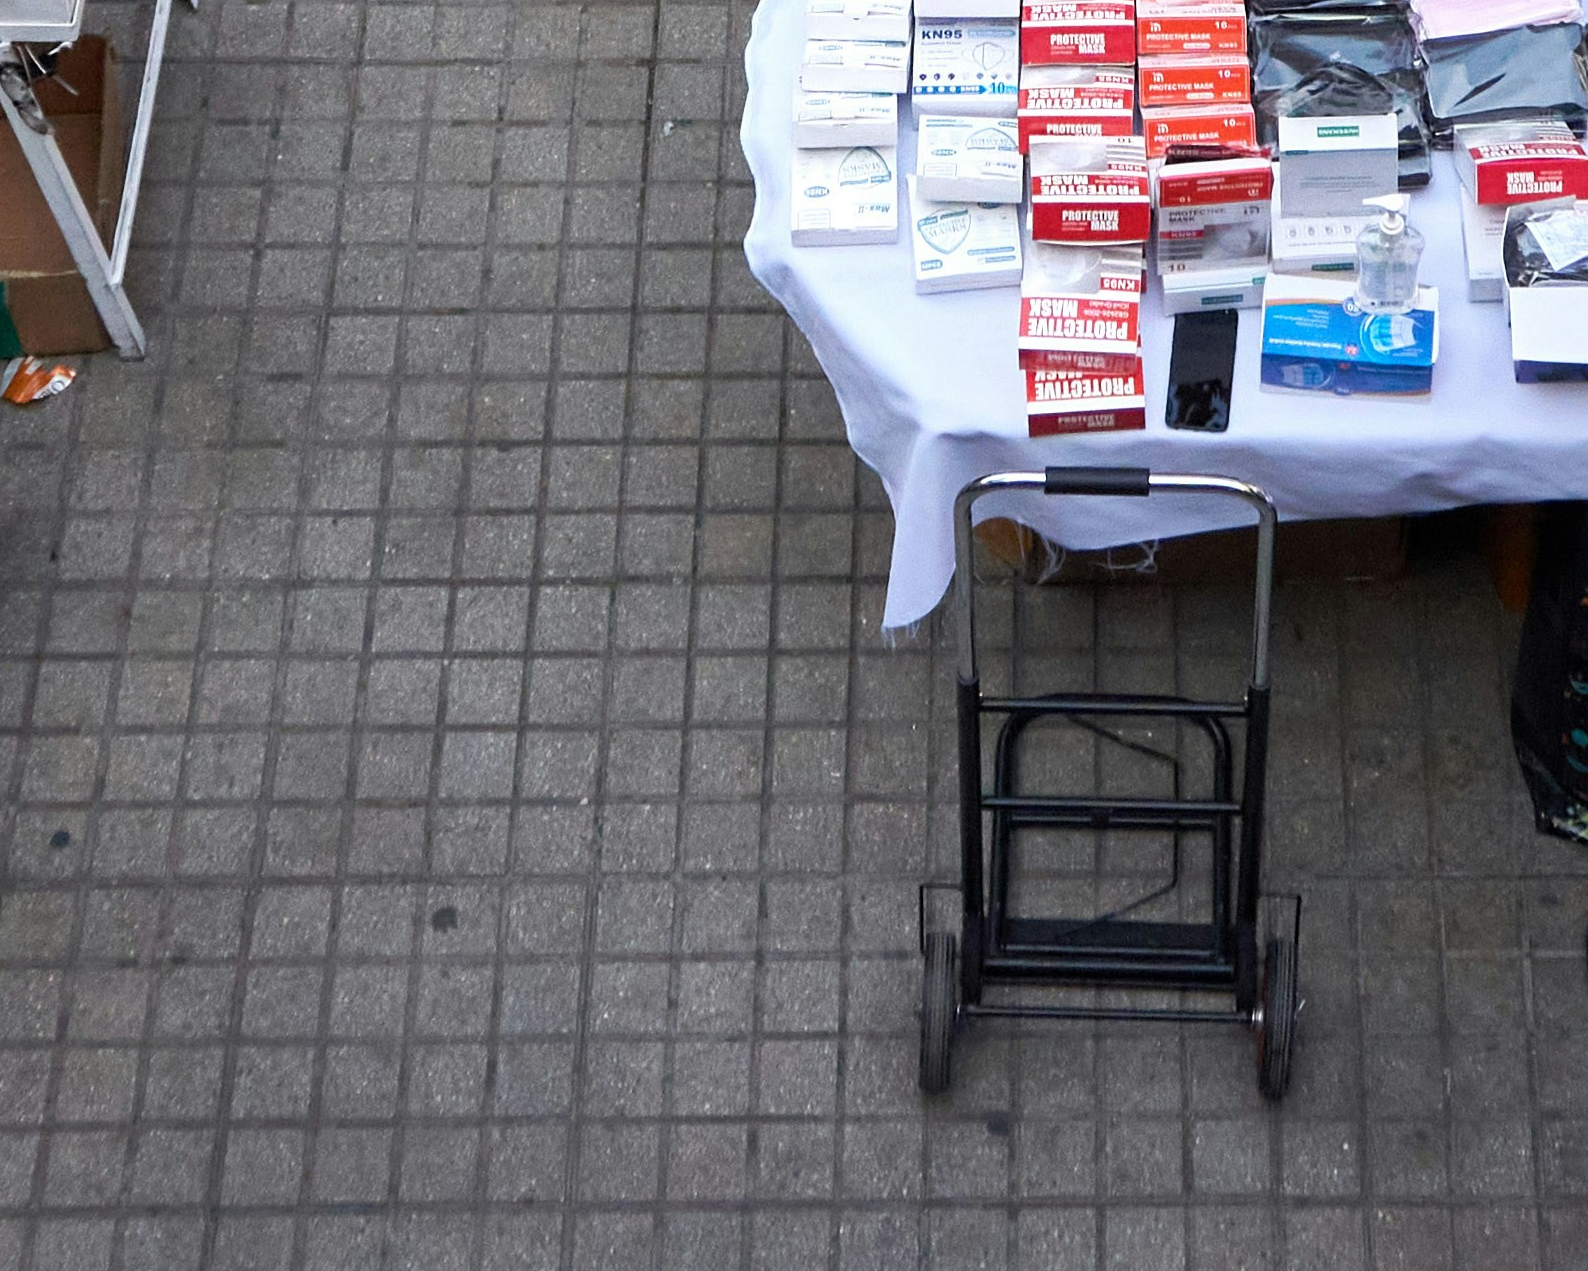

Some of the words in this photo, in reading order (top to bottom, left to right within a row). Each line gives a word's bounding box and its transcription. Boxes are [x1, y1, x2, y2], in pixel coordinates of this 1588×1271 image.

[1032, 10, 1126, 21] PROTECTIVE
[921, 29, 963, 40] KN95
[1050, 33, 1106, 46] PROTECTIVE
[1078, 43, 1106, 55] MASK
[990, 81, 1006, 95] 10
[1028, 88, 1076, 99] MASK
[1026, 97, 1124, 110] PROTECTIVE
[1046, 123, 1103, 136] PROTECTIVE
[1039, 174, 1089, 186] MASK
[1506, 172, 1535, 184] MASK
[1039, 184, 1141, 197] PROTECTIVE
[1506, 181, 1563, 195] PROTECTIVE
[1061, 210, 1120, 222] PROTECTIVE
[1090, 220, 1120, 232] MASK
[1168, 264, 1187, 273] 10
[1102, 279, 1136, 290] KN95
[1028, 299, 1079, 319] MASK
[1027, 318, 1129, 342] PROTECTIVE
[1034, 376, 1136, 402] PROTECTIVE
